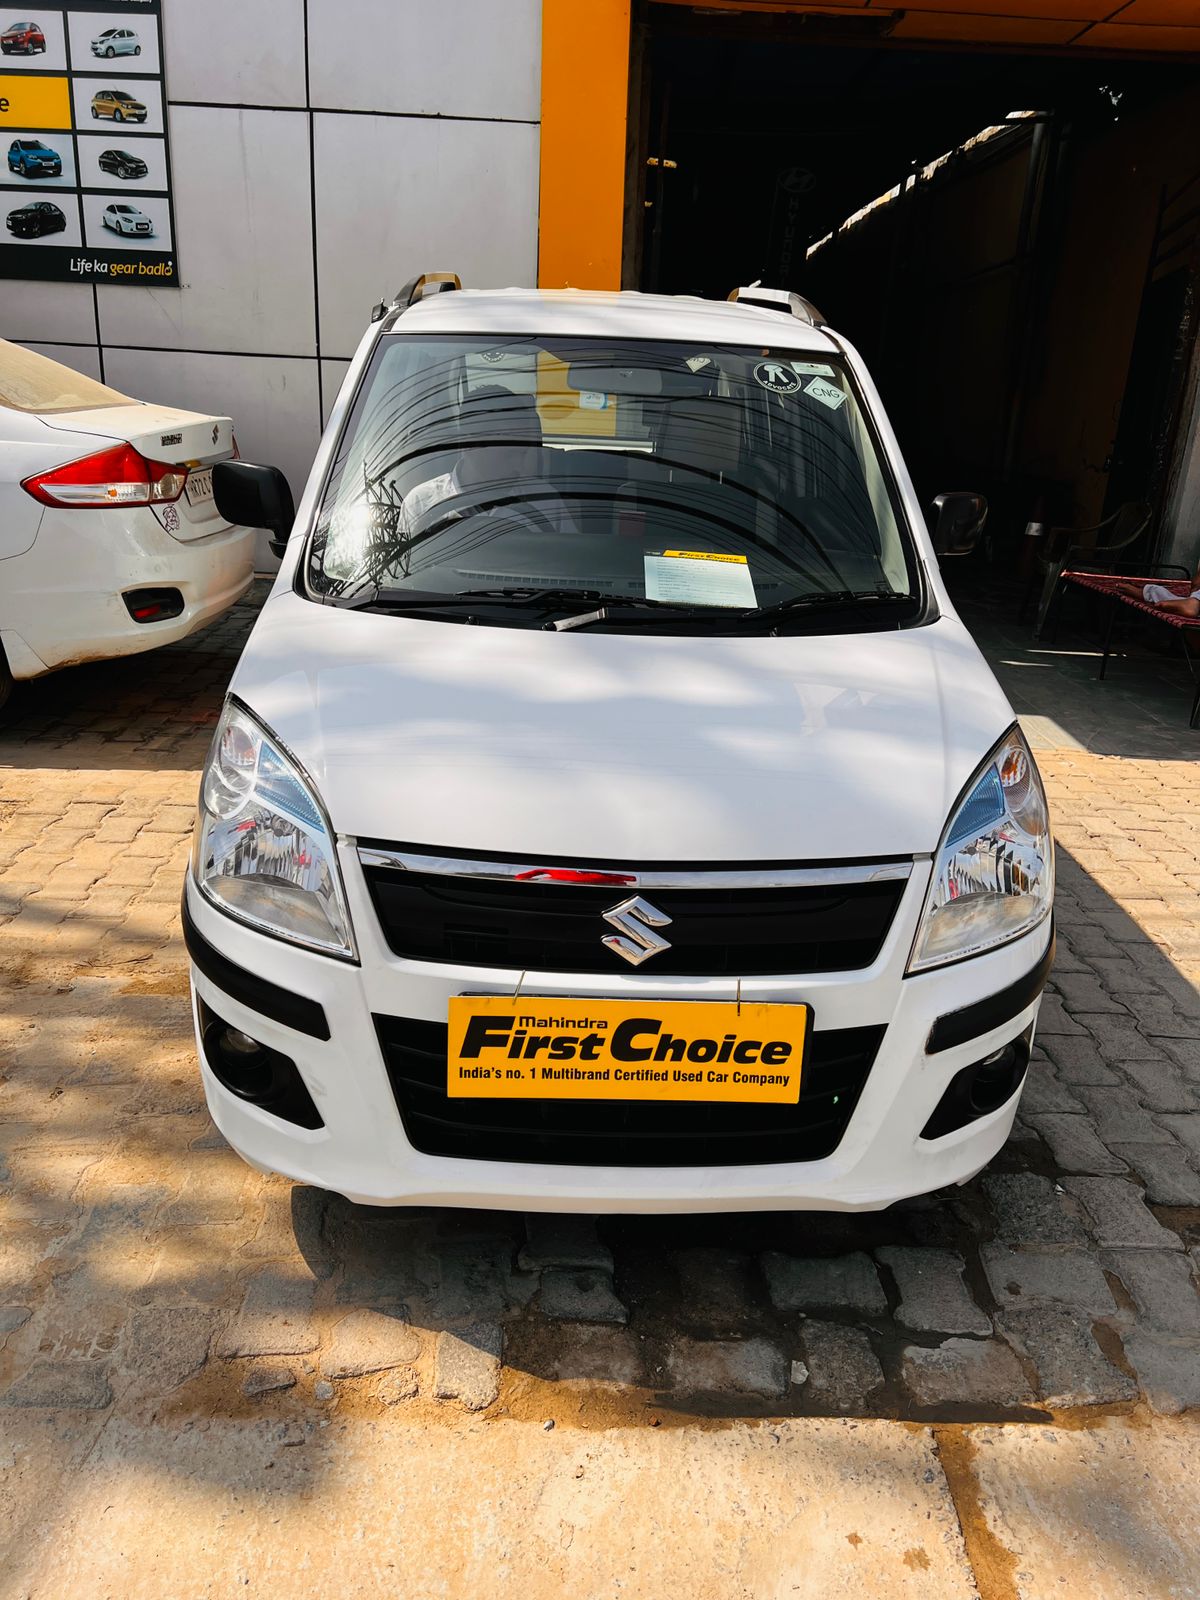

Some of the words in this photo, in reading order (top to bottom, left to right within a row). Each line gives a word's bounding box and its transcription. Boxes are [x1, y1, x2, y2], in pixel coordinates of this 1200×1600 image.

[70, 257, 93, 275] Life
[93, 259, 108, 273] ka
[109, 263, 137, 277] gear
[138, 261, 173, 276] badlo
[762, 380, 797, 391] ADVOCATE
[812, 387, 840, 399] CNG
[518, 1016, 608, 1029] Mahindra
[458, 1015, 606, 1061] First
[610, 1018, 793, 1065] Choice
[459, 1066, 502, 1079] India's
[505, 1069, 525, 1079] no.
[529, 1067, 536, 1079] 1
[541, 1067, 610, 1081] Multibrand
[614, 1068, 669, 1082] Certified
[672, 1070, 703, 1082] Used
[706, 1071, 729, 1083] Car
[732, 1072, 790, 1087] Company
